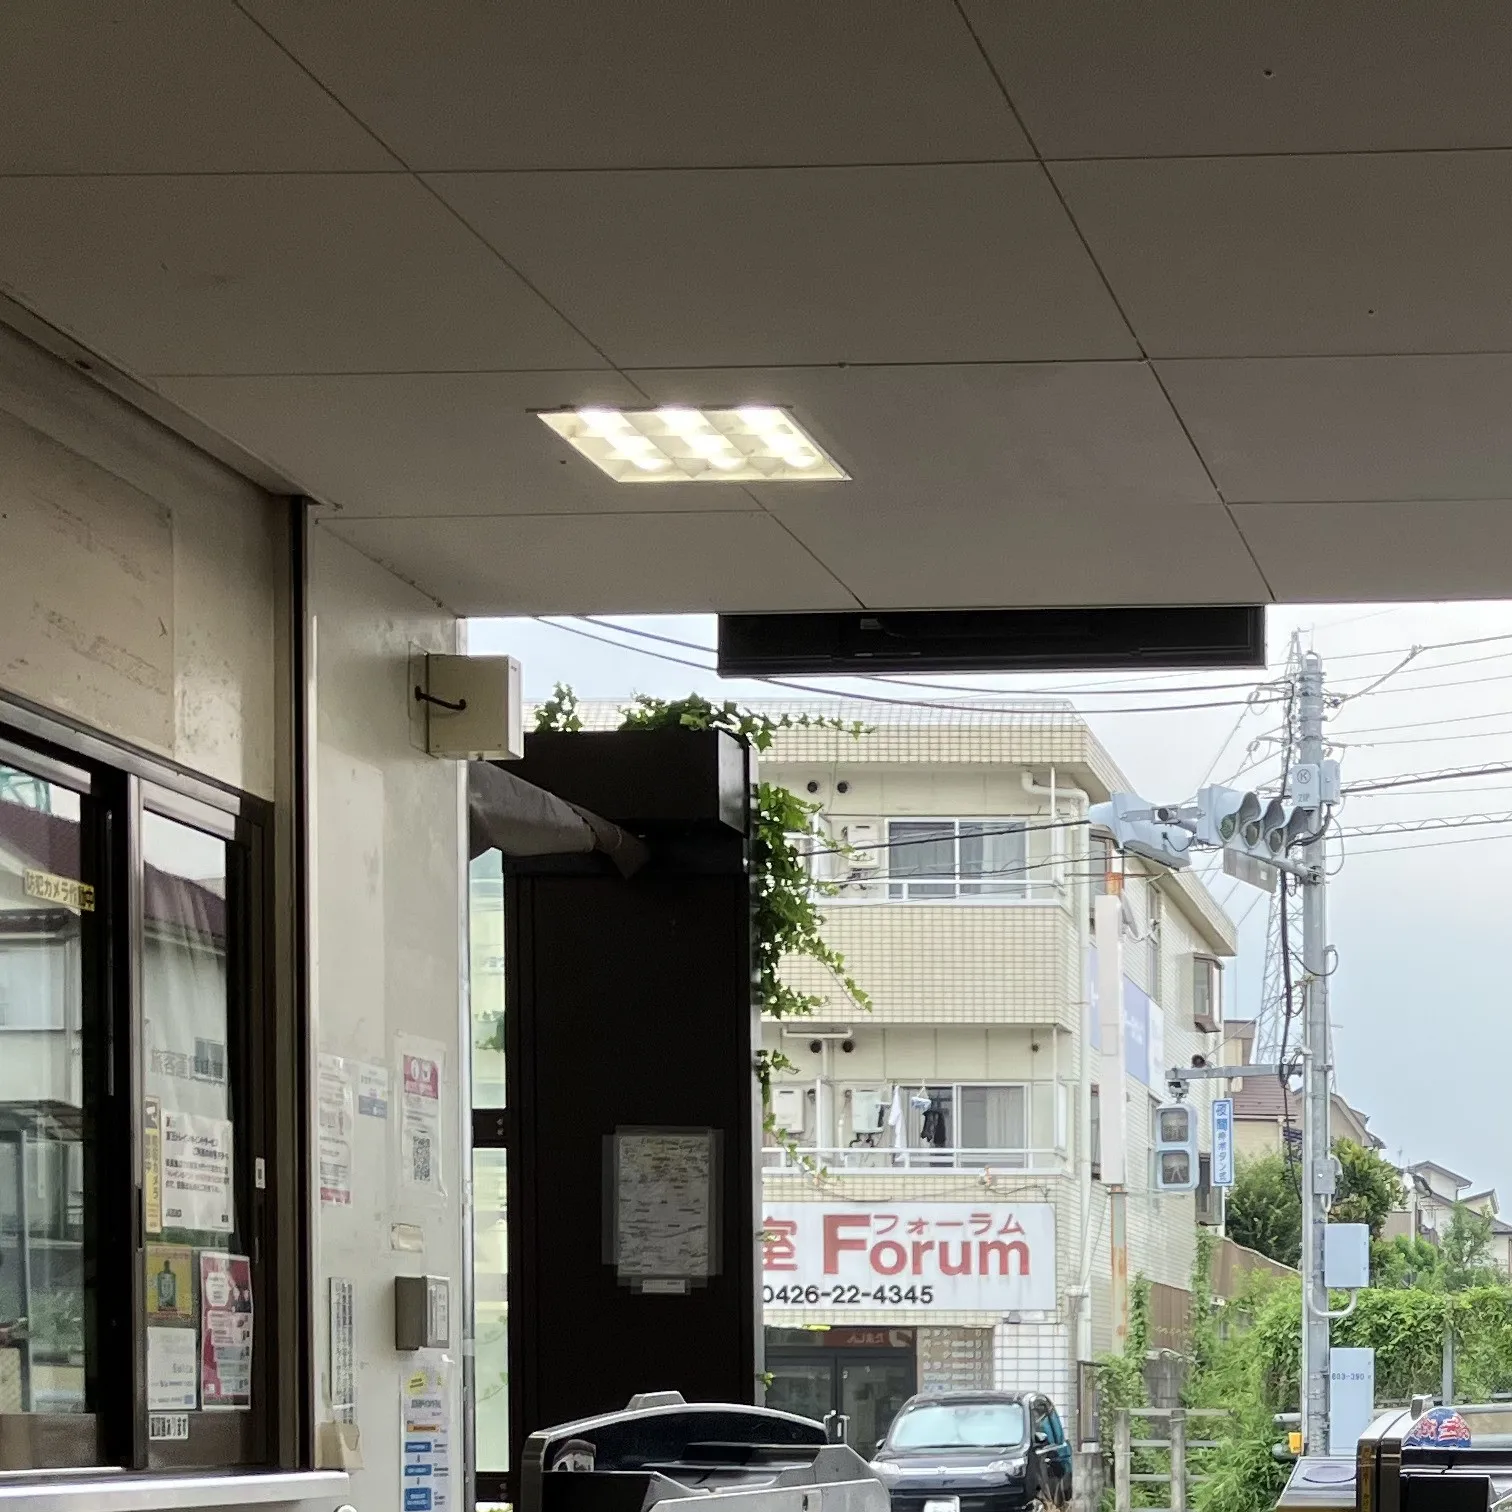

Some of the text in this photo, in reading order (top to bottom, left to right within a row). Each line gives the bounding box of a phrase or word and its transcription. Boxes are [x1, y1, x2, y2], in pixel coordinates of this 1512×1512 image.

[873, 1213, 1026, 1236] フォーラム
[823, 1214, 1030, 1276] Forum
[763, 1285, 934, 1305] 0426-22-4345
